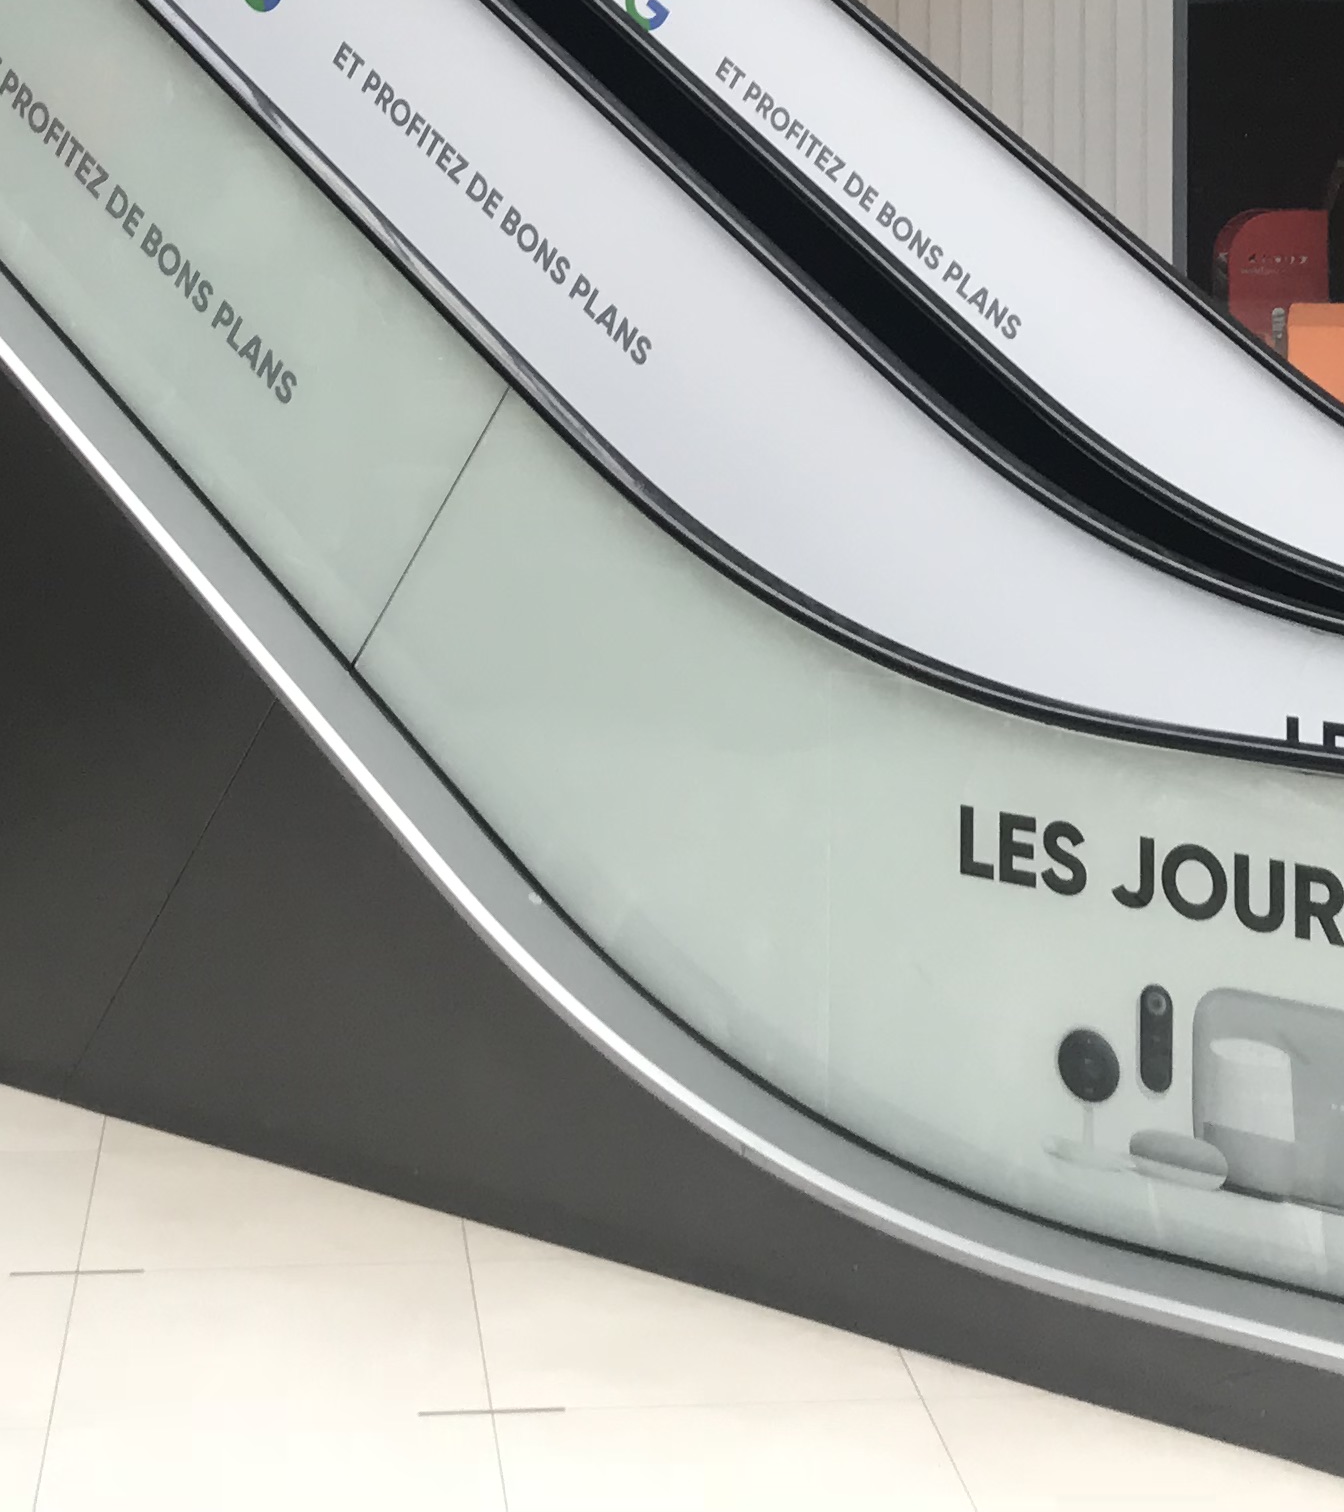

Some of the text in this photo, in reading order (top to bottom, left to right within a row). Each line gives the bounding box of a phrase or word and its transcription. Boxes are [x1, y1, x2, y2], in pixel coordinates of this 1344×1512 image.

[104, 184, 146, 239] DE
[140, 223, 215, 314] BONS
[210, 299, 298, 405] PLANS
[332, 41, 653, 366] ET PROFITEZ DE BONS PLANS
[714, 56, 1023, 341] ET PROFITEZ DE BONS PLANS
[958, 805, 1089, 896] LES
